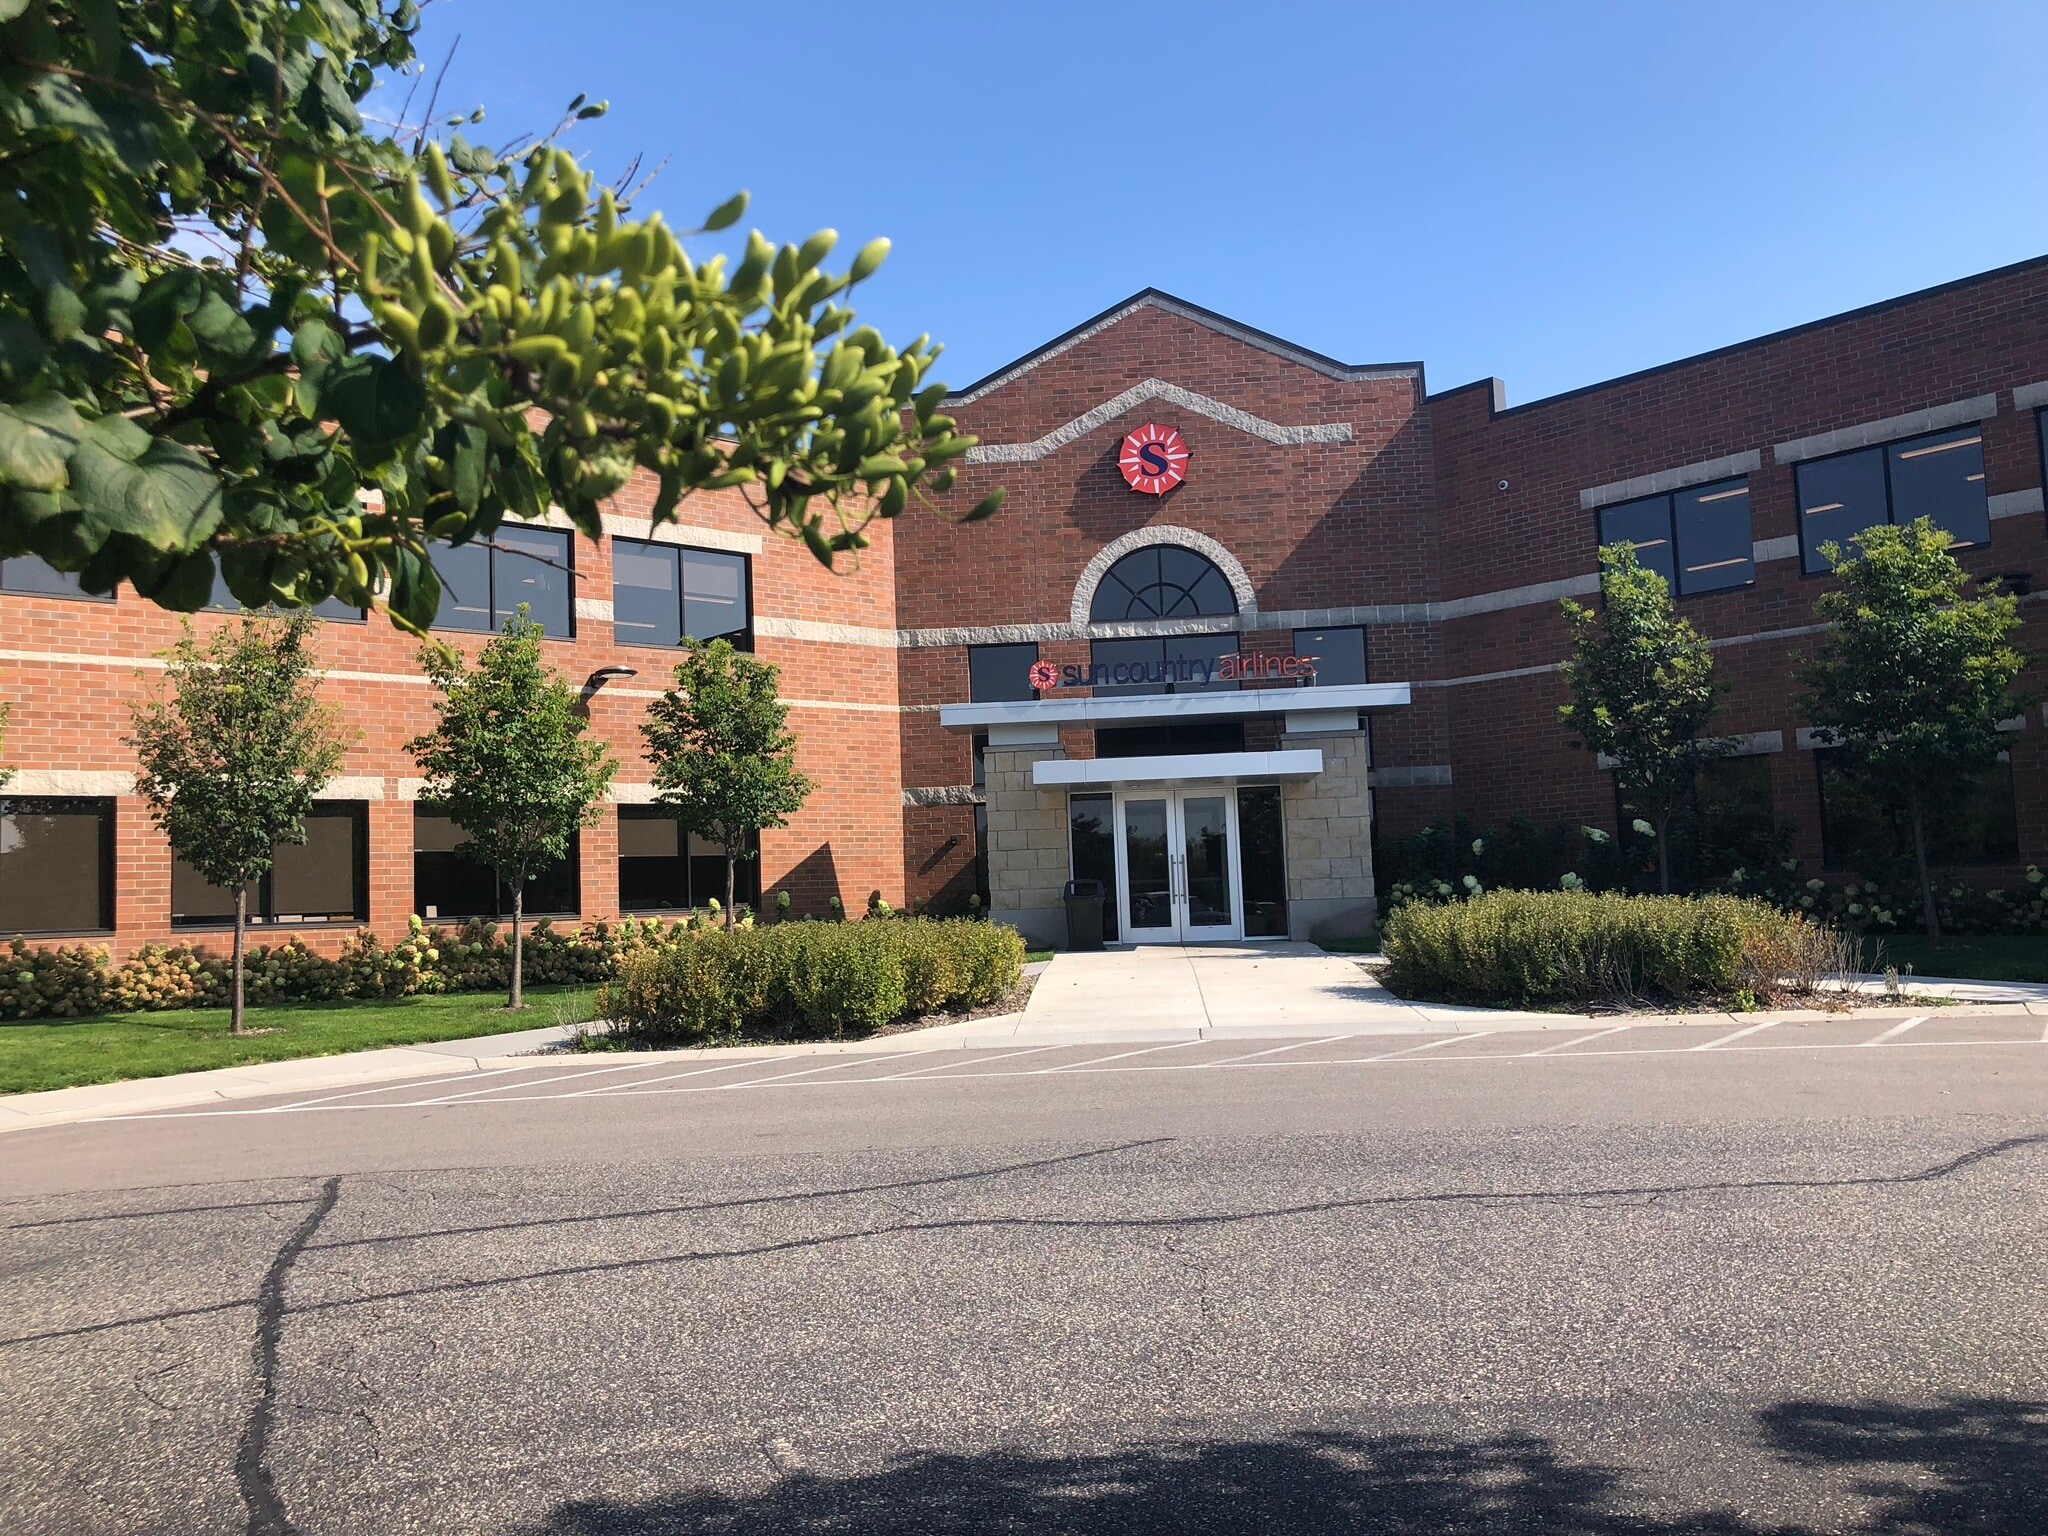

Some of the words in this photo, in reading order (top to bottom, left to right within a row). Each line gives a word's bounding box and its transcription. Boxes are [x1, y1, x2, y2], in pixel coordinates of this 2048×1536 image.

[1140, 442, 1168, 477] S
[1037, 666, 1051, 682] S
[1219, 650, 1315, 680] airlines
